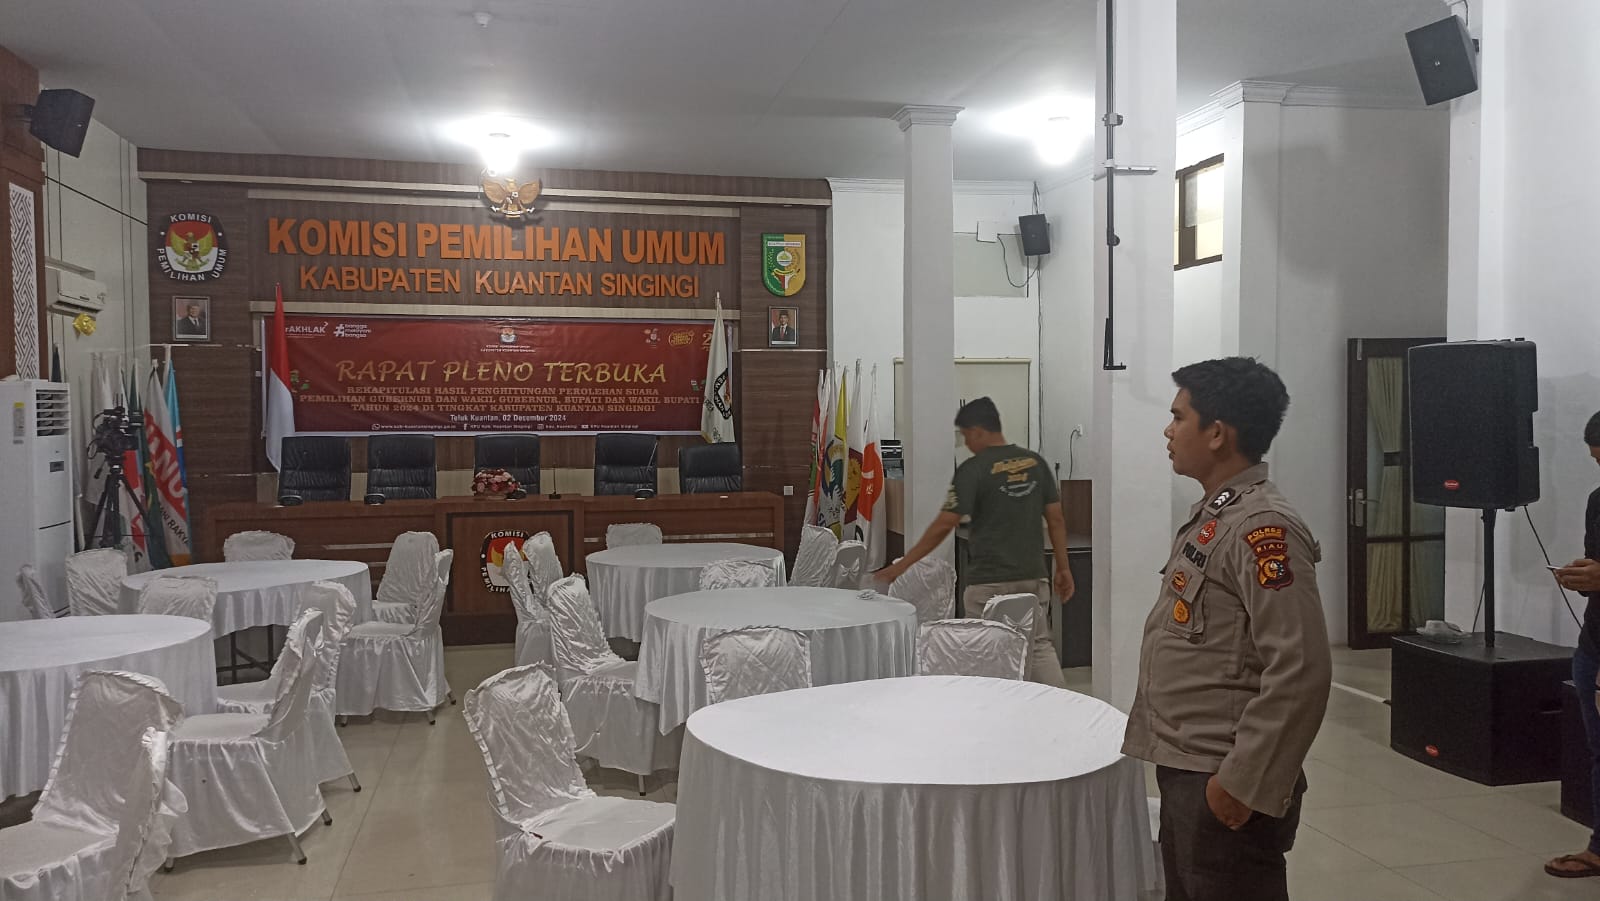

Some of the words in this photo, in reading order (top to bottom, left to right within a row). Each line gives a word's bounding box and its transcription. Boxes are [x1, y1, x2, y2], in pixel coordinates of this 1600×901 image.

[170, 213, 212, 223] KOMISI
[268, 217, 407, 257] KOMISI
[417, 223, 613, 264] PEMILIHAN
[622, 230, 726, 266] UMUM
[157, 248, 205, 281] PEMILIHAN
[211, 248, 227, 278] UMUM
[300, 266, 461, 294] KABUPATEN
[475, 270, 593, 297] KUANTAN
[600, 273, 700, 299] SINGINGI
[285, 321, 329, 334] rAKHLAK
[336, 359, 435, 382] RAPAT
[442, 360, 534, 383] PLENO
[543, 361, 667, 384] TERBUKA
[347, 386, 432, 395] REKAPITULASI
[434, 387, 467, 395] HASIL
[470, 387, 556, 396] PENGHITUNGAN
[558, 388, 623, 396] PEROLEHAN
[625, 388, 659, 396] SUARA
[300, 395, 364, 403] PEMILIHAN
[369, 395, 433, 404] GUBERNUR
[435, 395, 459, 404] DAN
[563, 396, 602, 405] BUPATI
[604, 397, 626, 405] DAN
[627, 397, 661, 405] WAKIL
[664, 397, 700, 405] BUPATI
[351, 404, 390, 412] TAHUN
[393, 404, 420, 412] 2024
[422, 404, 436, 412] DI
[437, 404, 487, 412] TINGKAT
[490, 404, 555, 413] KABUPATEN
[556, 405, 605, 413] KUANTAN
[607, 405, 656, 413] SINGINGI
[502, 414, 511, 422] 02
[491, 530, 524, 539] KOMISI
[1256, 543, 1283, 552] RIAU
[481, 567, 511, 593] PEMILIH
